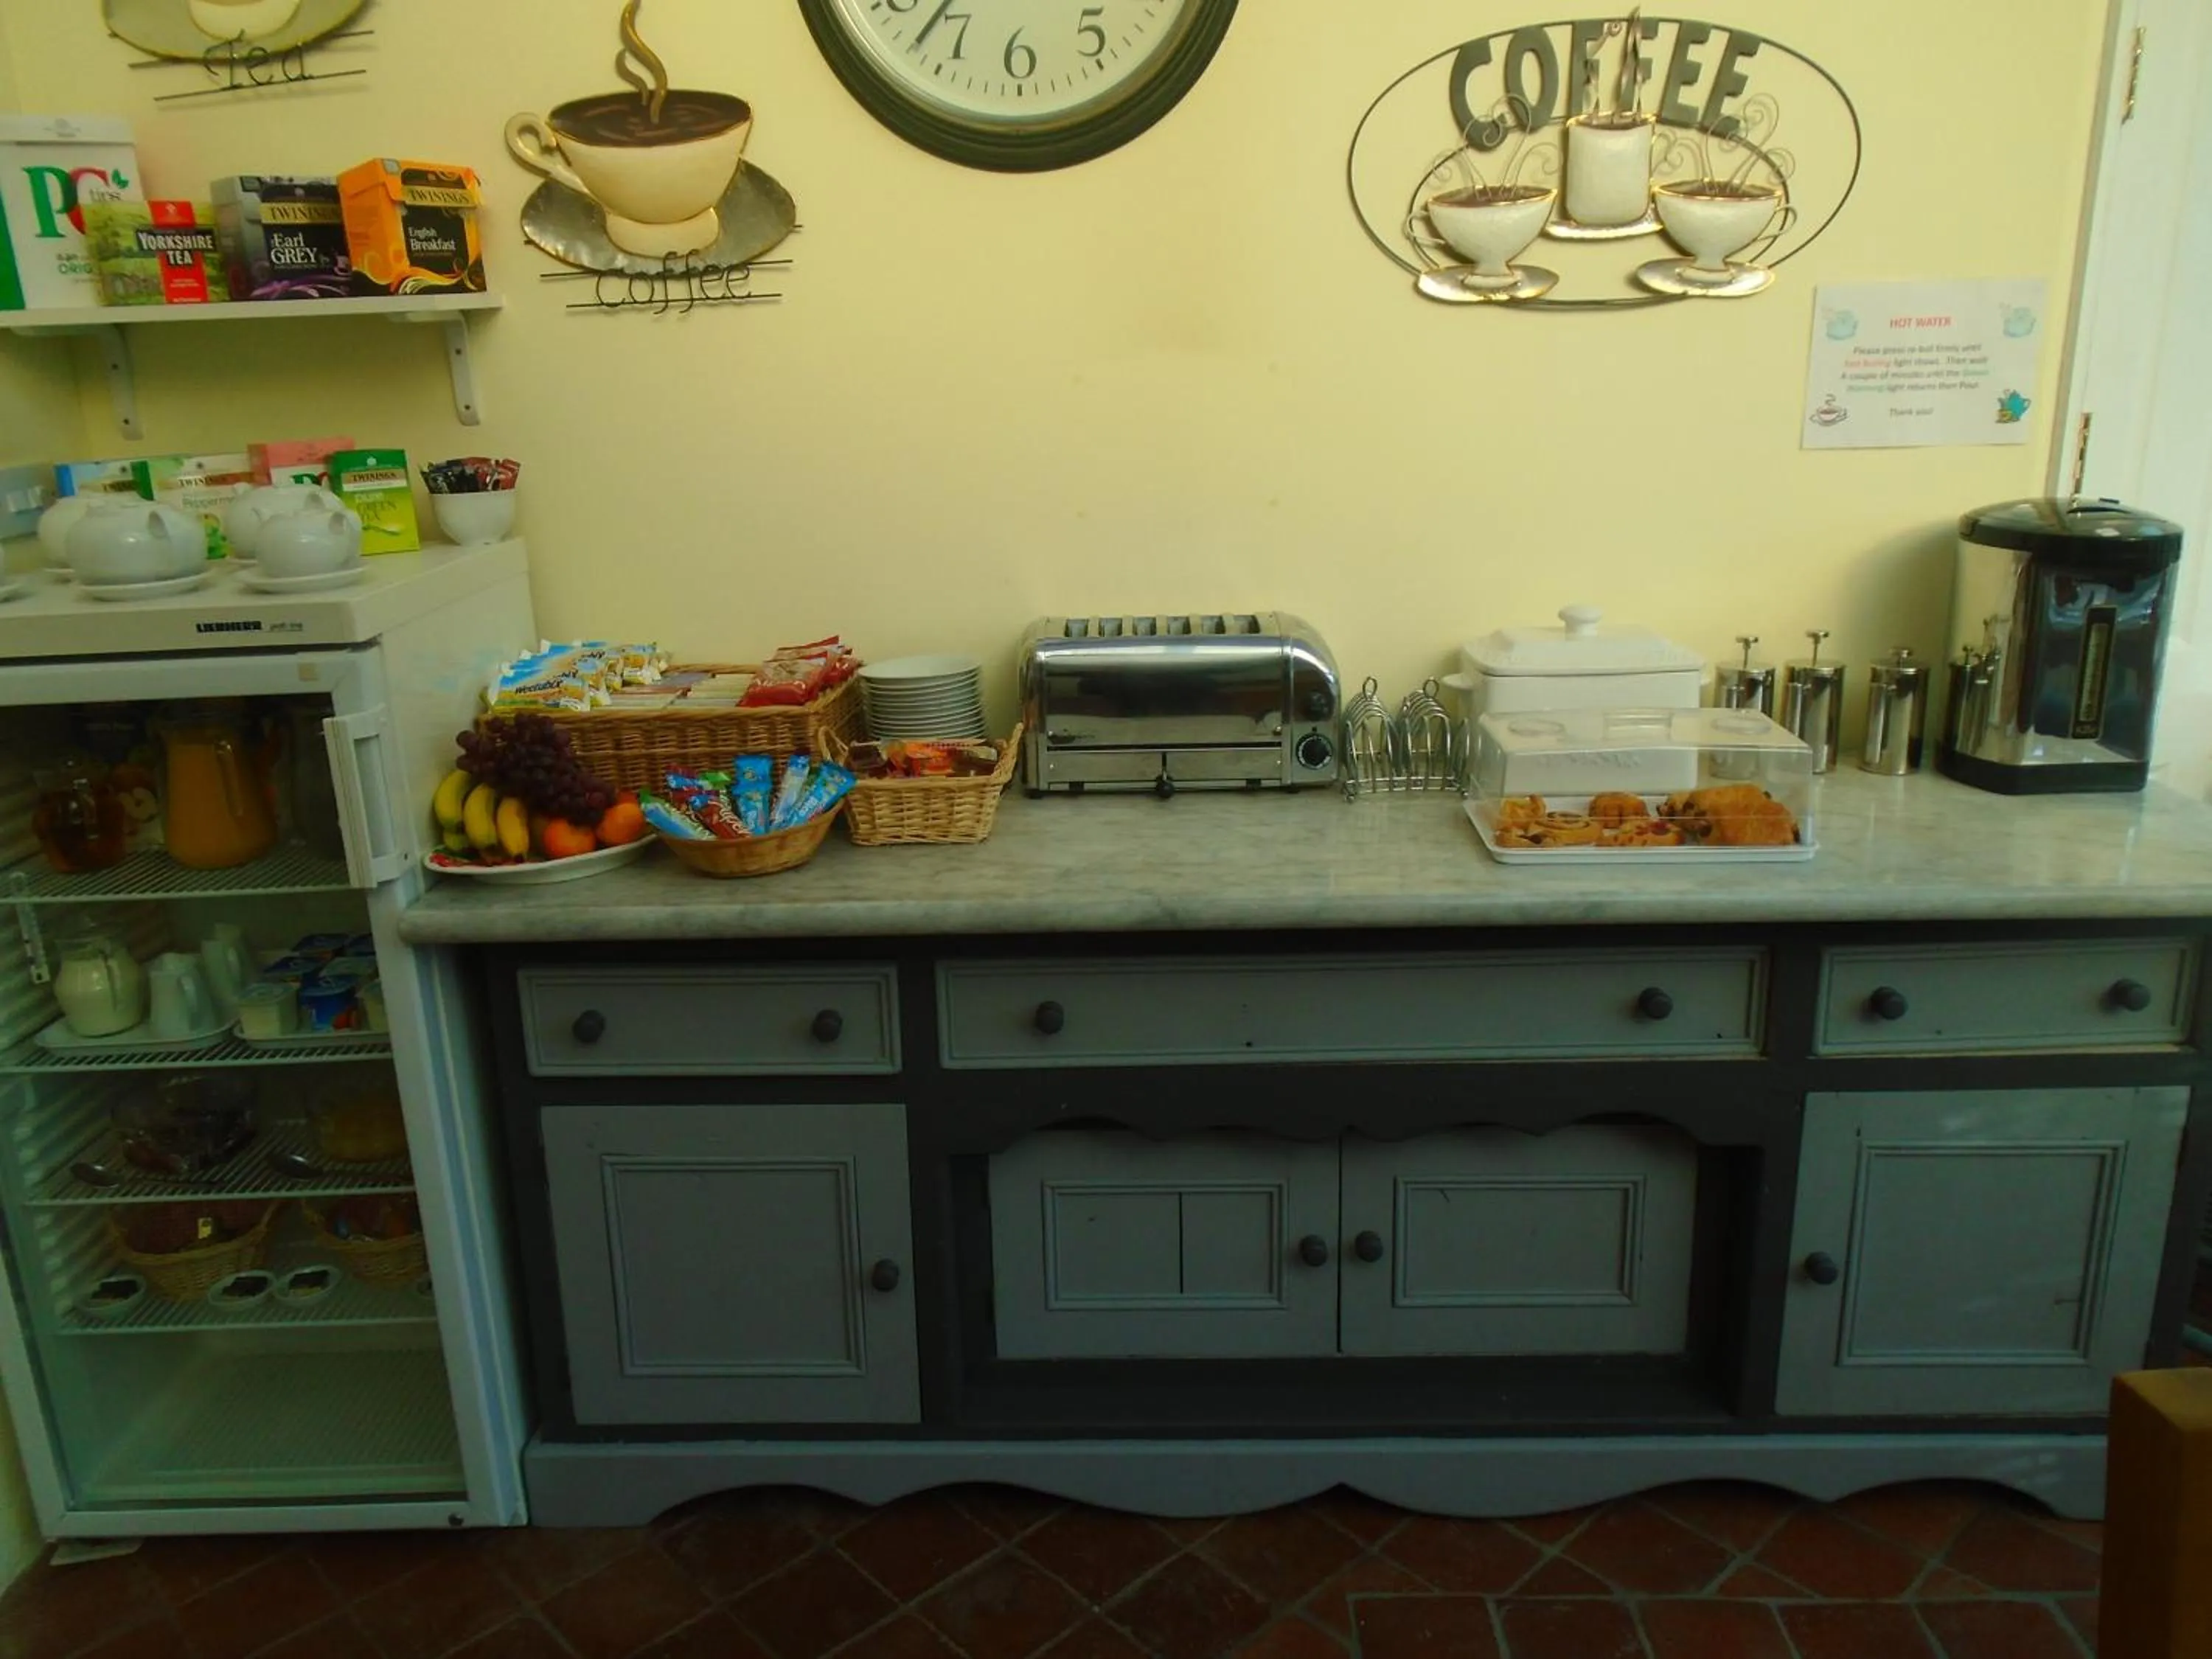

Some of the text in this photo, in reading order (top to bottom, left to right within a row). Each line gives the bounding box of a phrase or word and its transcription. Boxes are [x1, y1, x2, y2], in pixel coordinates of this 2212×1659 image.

[945, 13, 972, 59] 7
[1077, 7, 1106, 57] 5
[1003, 26, 1037, 79] 6
[1449, 18, 1764, 152] COFFEE
[409, 189, 470, 204] TWININGS
[138, 231, 215, 250] YORKSHIRE
[273, 232, 305, 248] Earl
[408, 226, 438, 240] English
[410, 237, 456, 251] Breakfast
[166, 250, 193, 266] TEA
[271, 247, 318, 265] GREY
[1890, 316, 1952, 329] HOT WATER
[352, 471, 397, 482] TWININGS
